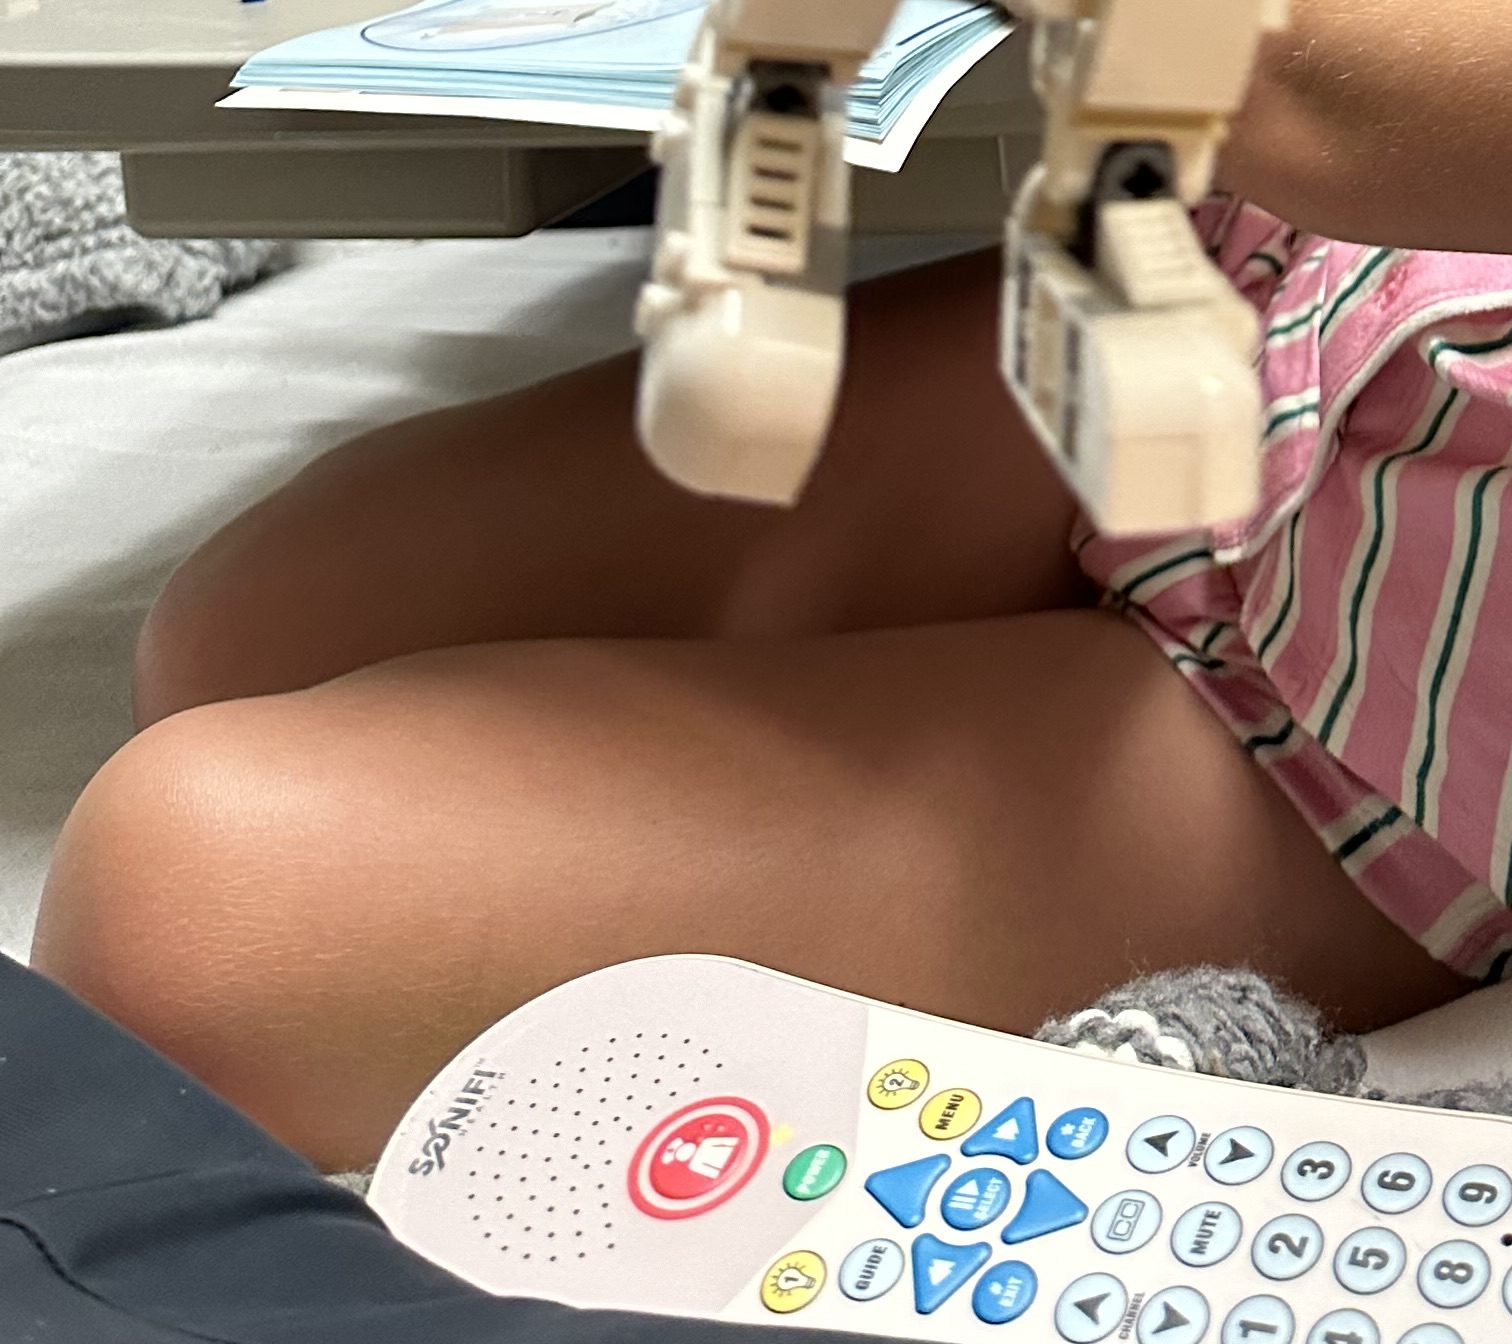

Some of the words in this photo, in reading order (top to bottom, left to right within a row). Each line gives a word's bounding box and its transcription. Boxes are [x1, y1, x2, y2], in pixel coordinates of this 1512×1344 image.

[889, 1076, 904, 1088] 2
[409, 1069, 497, 1176] SONIFI
[935, 1094, 965, 1131] MENU
[1070, 1116, 1097, 1149] BACK
[1187, 1132, 1212, 1168] VOLUME
[794, 1149, 831, 1194] POWER
[1297, 1158, 1335, 1180] 3
[1377, 1170, 1416, 1192] 6
[972, 1177, 1004, 1220] SELECT
[1458, 1181, 1498, 1204] 9
[1190, 1209, 1222, 1256] MUTE
[1268, 1232, 1309, 1258] 2
[855, 1245, 888, 1291] GUIDE
[1348, 1246, 1389, 1270] 5
[1434, 1260, 1474, 1284] 8
[784, 1274, 799, 1284] 1
[998, 1276, 1023, 1308] EXIT
[1118, 1292, 1146, 1341] CHANNEL
[1239, 1319, 1278, 1338] 1
